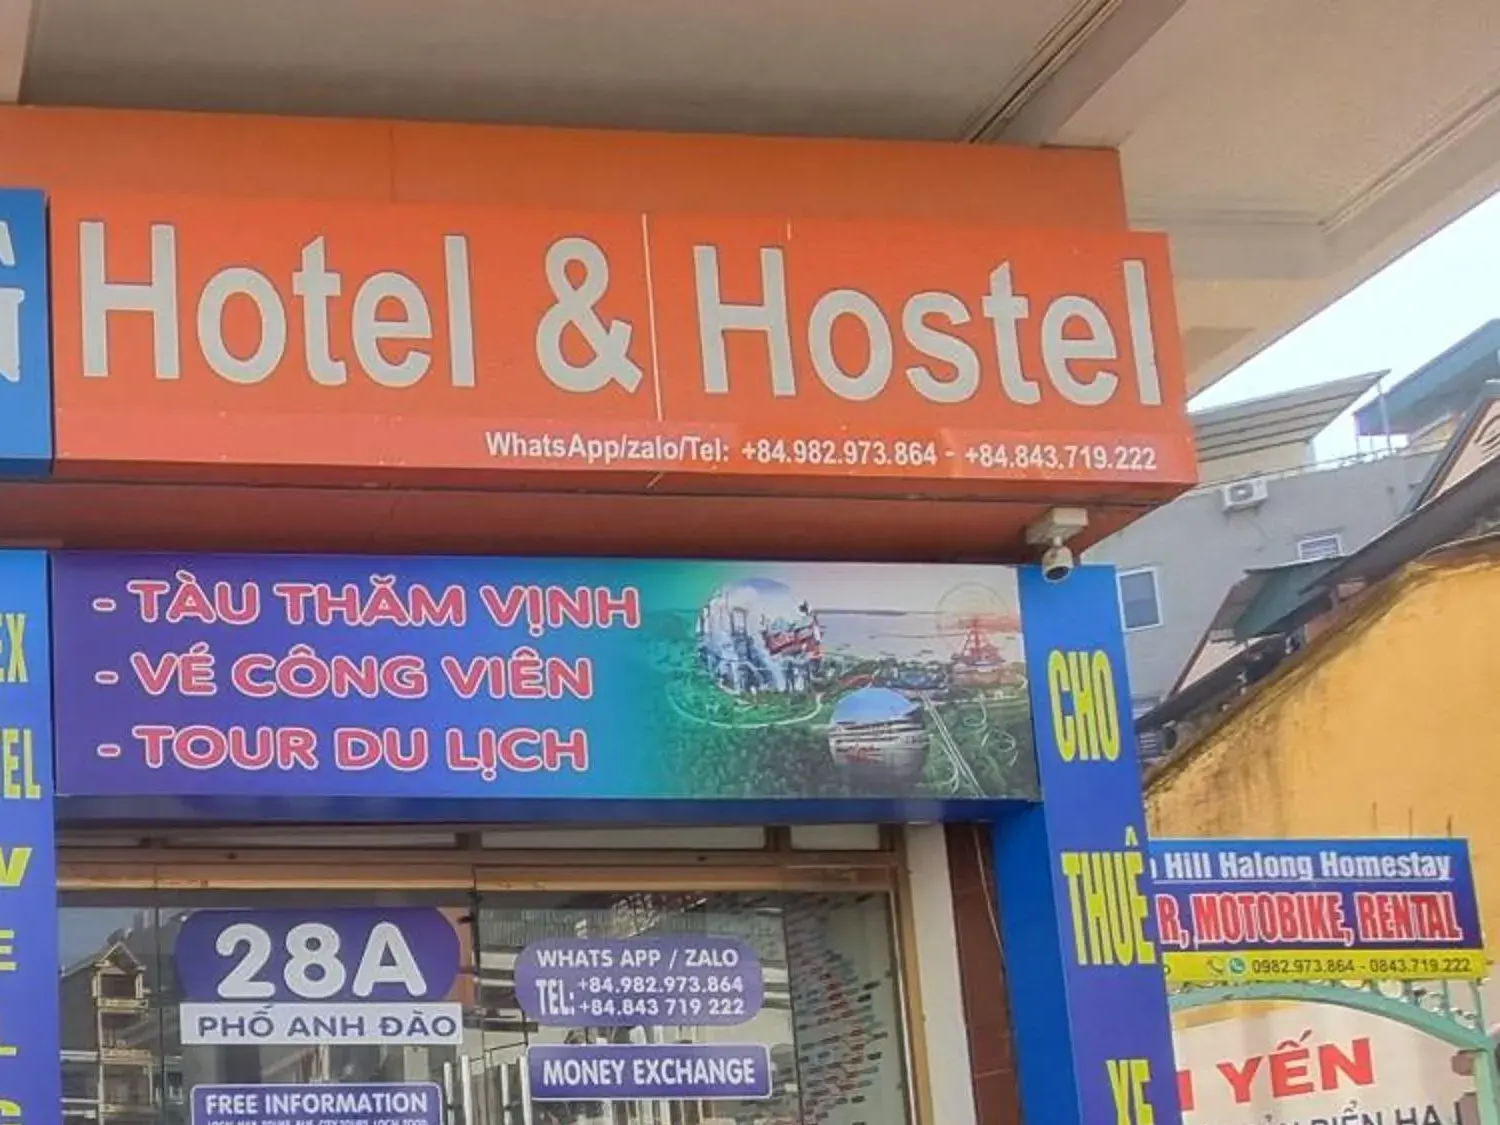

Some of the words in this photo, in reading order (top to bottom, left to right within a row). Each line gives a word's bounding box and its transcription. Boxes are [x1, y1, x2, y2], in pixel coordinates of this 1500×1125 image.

[79, 220, 475, 389] Hotel
[535, 235, 644, 395] &
[692, 244, 1163, 407] Hostel
[741, 439, 937, 467] +84.982.973.864
[963, 443, 1158, 471] +84.843.719.222
[127, 571, 260, 625] TÀU
[274, 574, 467, 628] THĂM
[479, 585, 640, 637] VỊNH
[131, 642, 218, 696] VÉ
[231, 644, 429, 699] CÔNG
[441, 646, 593, 700] VIÊN
[1047, 649, 1120, 762] CHO
[132, 725, 318, 771] TOUR
[334, 727, 429, 771] DU
[446, 728, 589, 782] LỊCH
[1165, 851, 1211, 879] Hill
[1219, 851, 1314, 881] Halong
[1320, 852, 1451, 881] Homestay
[1061, 825, 1156, 966] THUÊ
[1155, 893, 1190, 949] R,
[1354, 891, 1464, 941] RENTAL
[215, 921, 427, 999] 28A
[536, 949, 613, 968] WHATS
[620, 949, 661, 967] APP
[685, 949, 739, 967] ZALO
[578, 976, 743, 993] +84.982.973.864
[287, 1015, 365, 1037] ANH
[667, 999, 701, 1015] 719
[708, 999, 745, 1015] 222
[543, 1060, 625, 1085] MONEY
[633, 1059, 756, 1085] EXCHANGE
[1216, 1029, 1374, 1104] YẾN
[205, 1094, 258, 1116] FREE
[265, 1092, 428, 1114] INFORMATION
